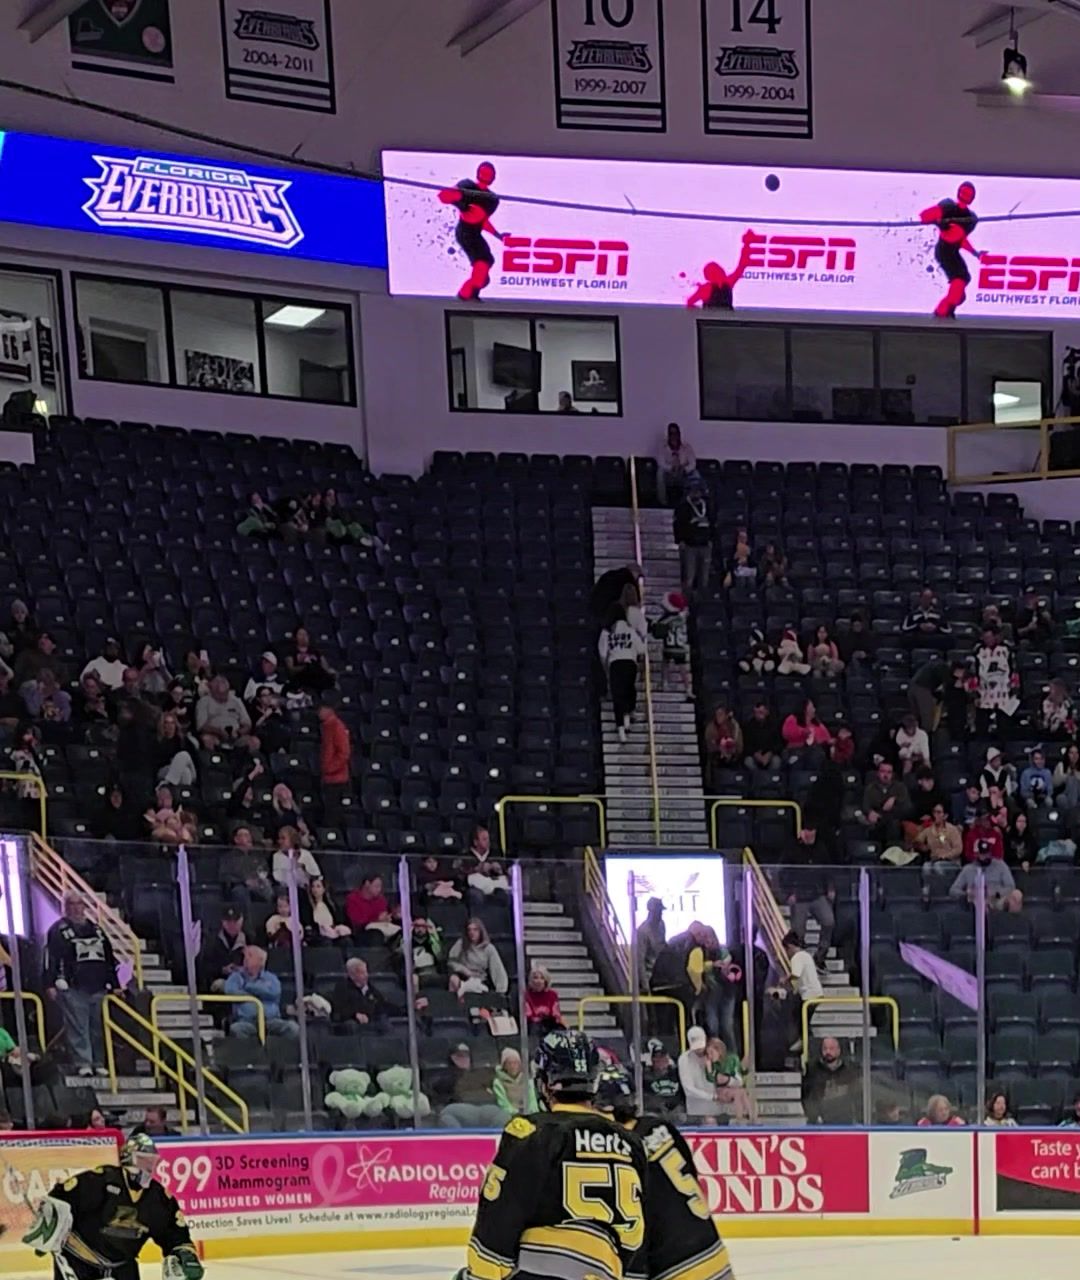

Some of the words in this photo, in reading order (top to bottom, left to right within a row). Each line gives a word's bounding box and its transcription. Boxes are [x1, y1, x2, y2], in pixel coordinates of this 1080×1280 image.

[574, 78, 647, 95] 1999-2007
[723, 84, 795, 100] 1999-2004
[138, 161, 246, 185] FLORIDA
[95, 164, 293, 238] EVERBLADES
[502, 236, 628, 276] ESPN
[745, 234, 856, 270] ESPN
[500, 276, 573, 288] SOUTHWEST
[742, 271, 805, 281] OUTHWEST
[976, 293, 1047, 305] SOUTHWEST
[1031, 1139, 1072, 1156] Taste
[216, 1156, 234, 1170] 3D
[240, 1153, 309, 1170] Screening
[1031, 1161, 1070, 1179] can't
[156, 1156, 212, 1192] $99
[218, 1175, 311, 1191] Mammogram
[429, 1183, 480, 1202] Region
[190, 1195, 260, 1210] UNINSURED
[265, 1193, 312, 1206] WOMEN
